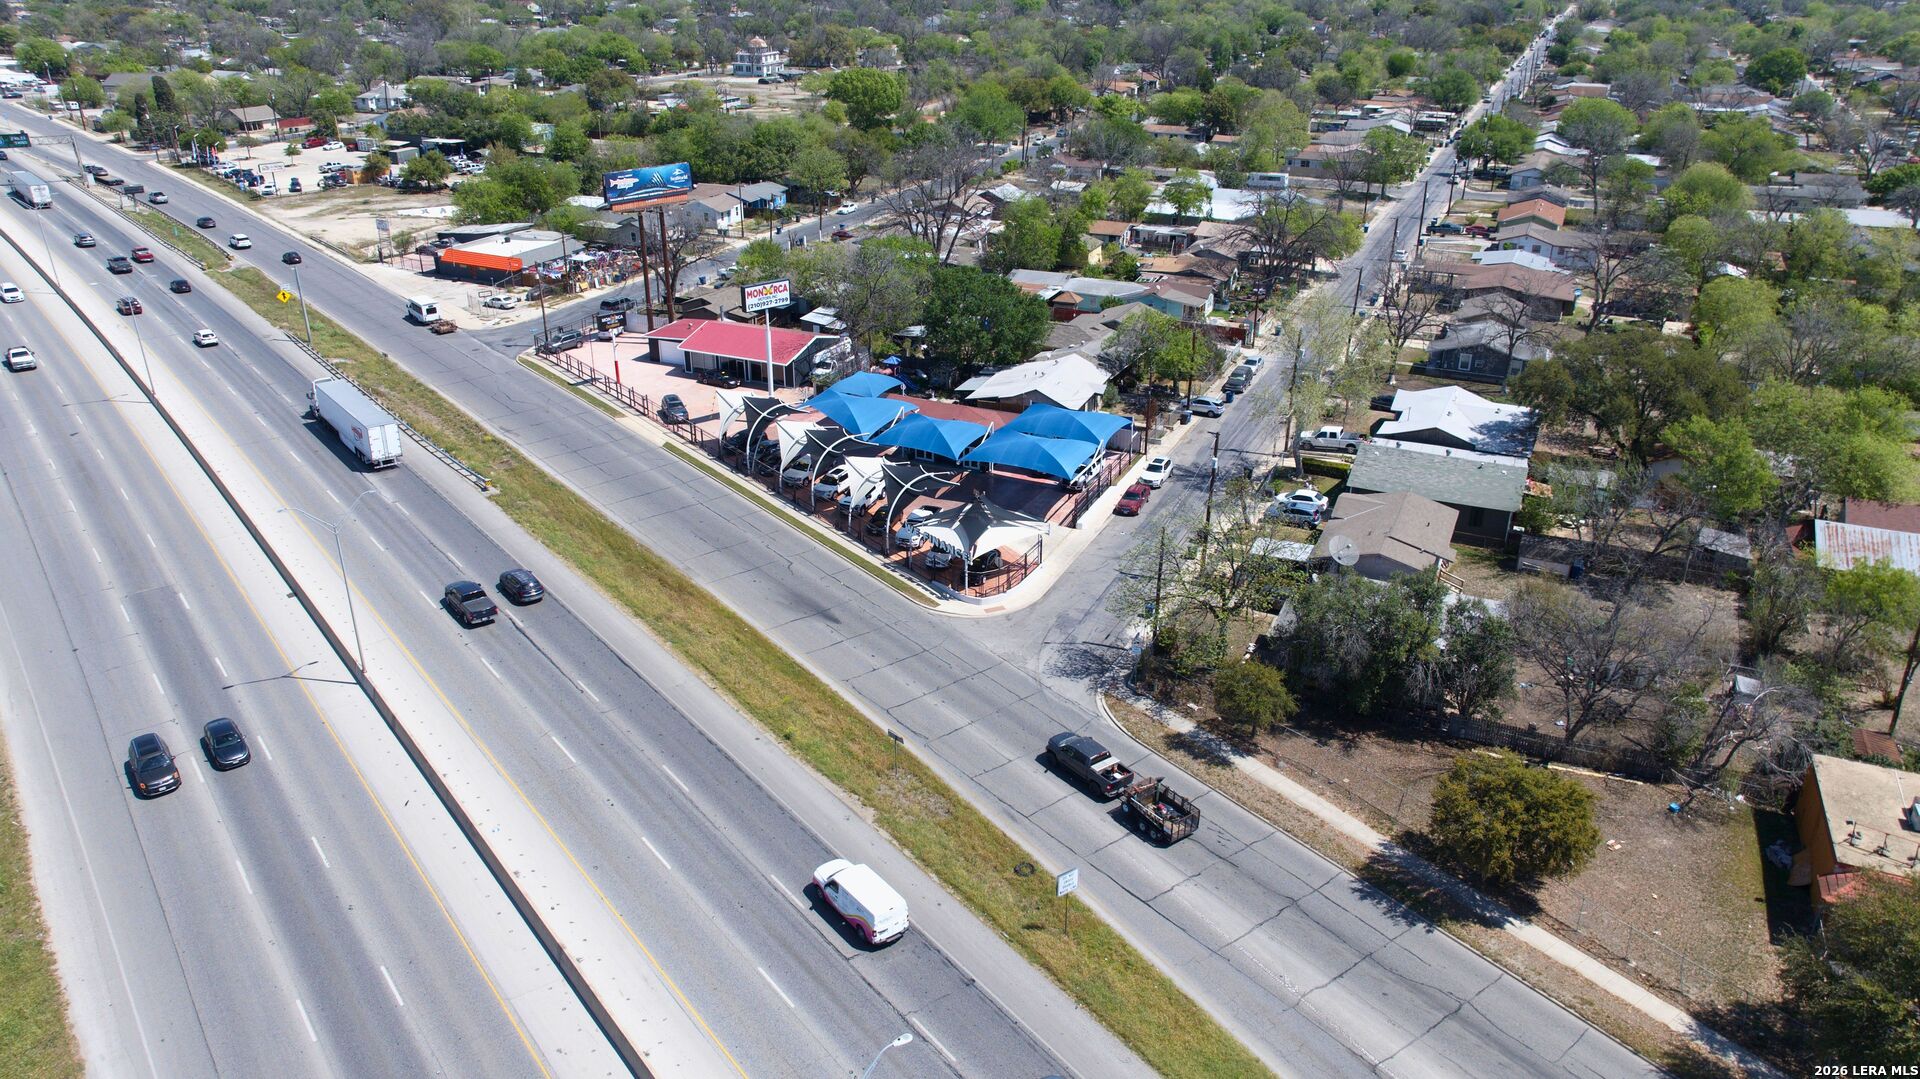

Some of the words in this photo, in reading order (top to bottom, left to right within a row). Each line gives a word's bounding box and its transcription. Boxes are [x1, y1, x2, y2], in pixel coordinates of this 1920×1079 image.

[746, 284, 788, 299] MONRCA
[904, 521, 921, 536] WE
[923, 532, 970, 561] FINANCE
